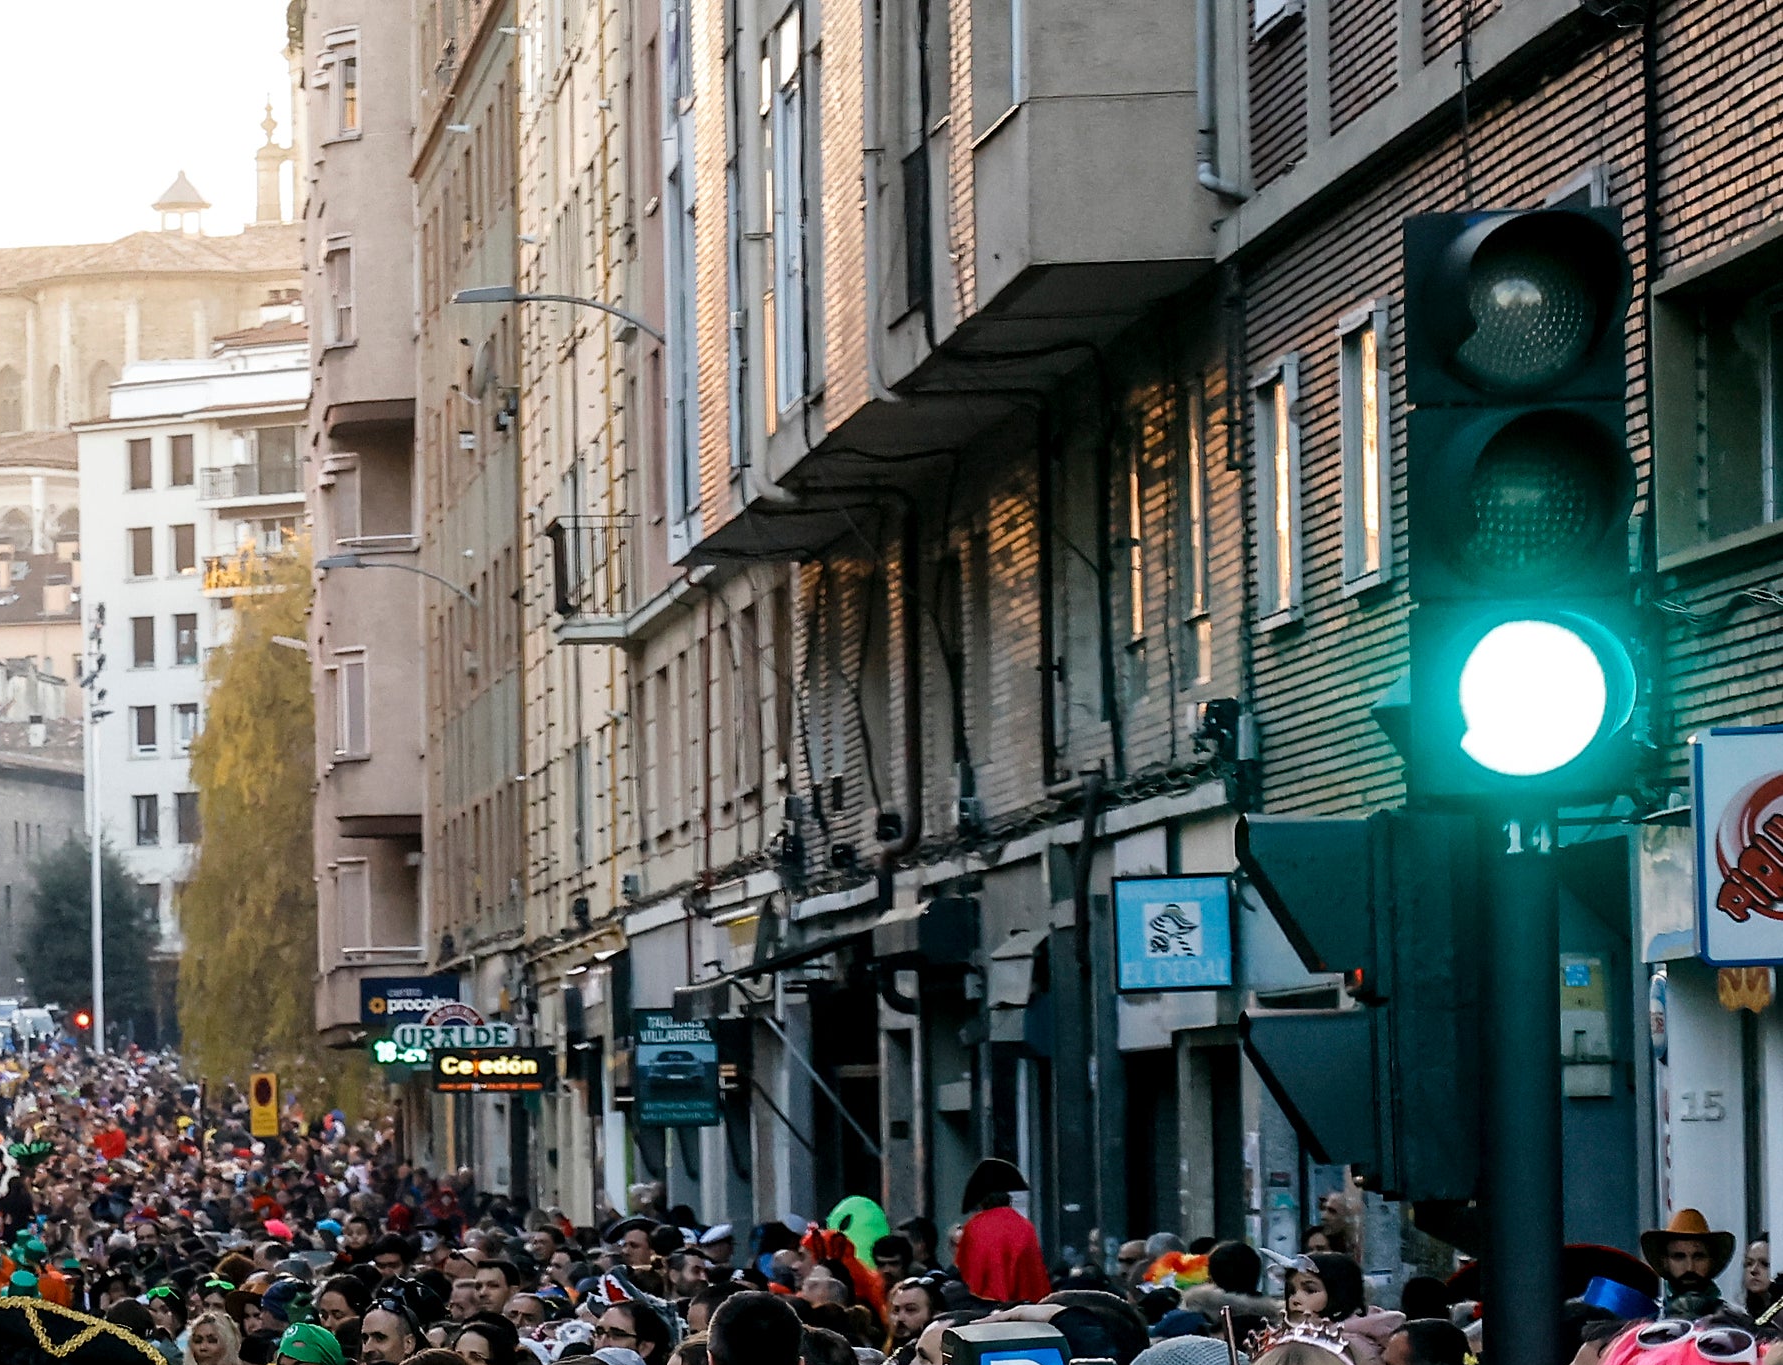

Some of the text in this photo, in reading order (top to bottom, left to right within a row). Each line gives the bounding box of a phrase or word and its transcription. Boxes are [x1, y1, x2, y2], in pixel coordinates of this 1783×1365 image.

[1502, 820, 1551, 854] 14
[387, 995, 457, 1015] procolo
[401, 1026, 511, 1050] URALDE
[1681, 1090, 1726, 1122] 15
